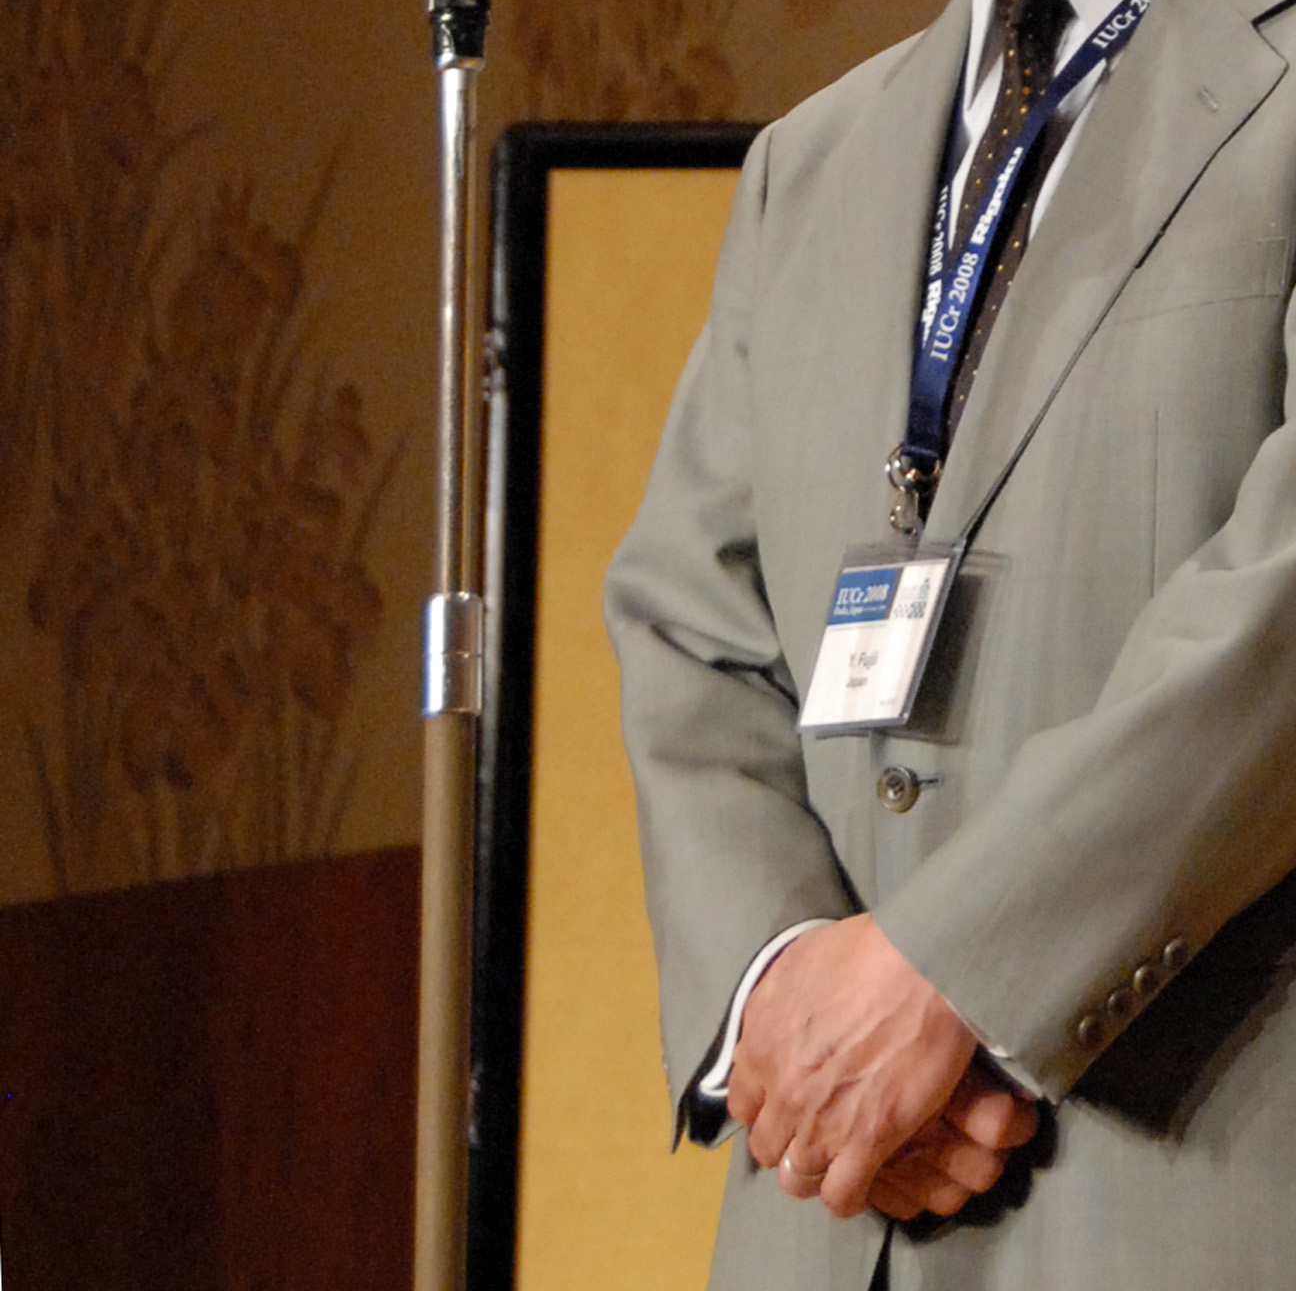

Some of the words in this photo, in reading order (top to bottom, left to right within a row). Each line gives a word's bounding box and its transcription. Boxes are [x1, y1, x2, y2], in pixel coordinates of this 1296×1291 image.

[1092, 9, 1138, 49] IUCr
[930, 306, 961, 361] IUCr
[949, 252, 979, 304] 2008
[970, 146, 1024, 245] Rigaku
[836, 587, 864, 605] IUCr
